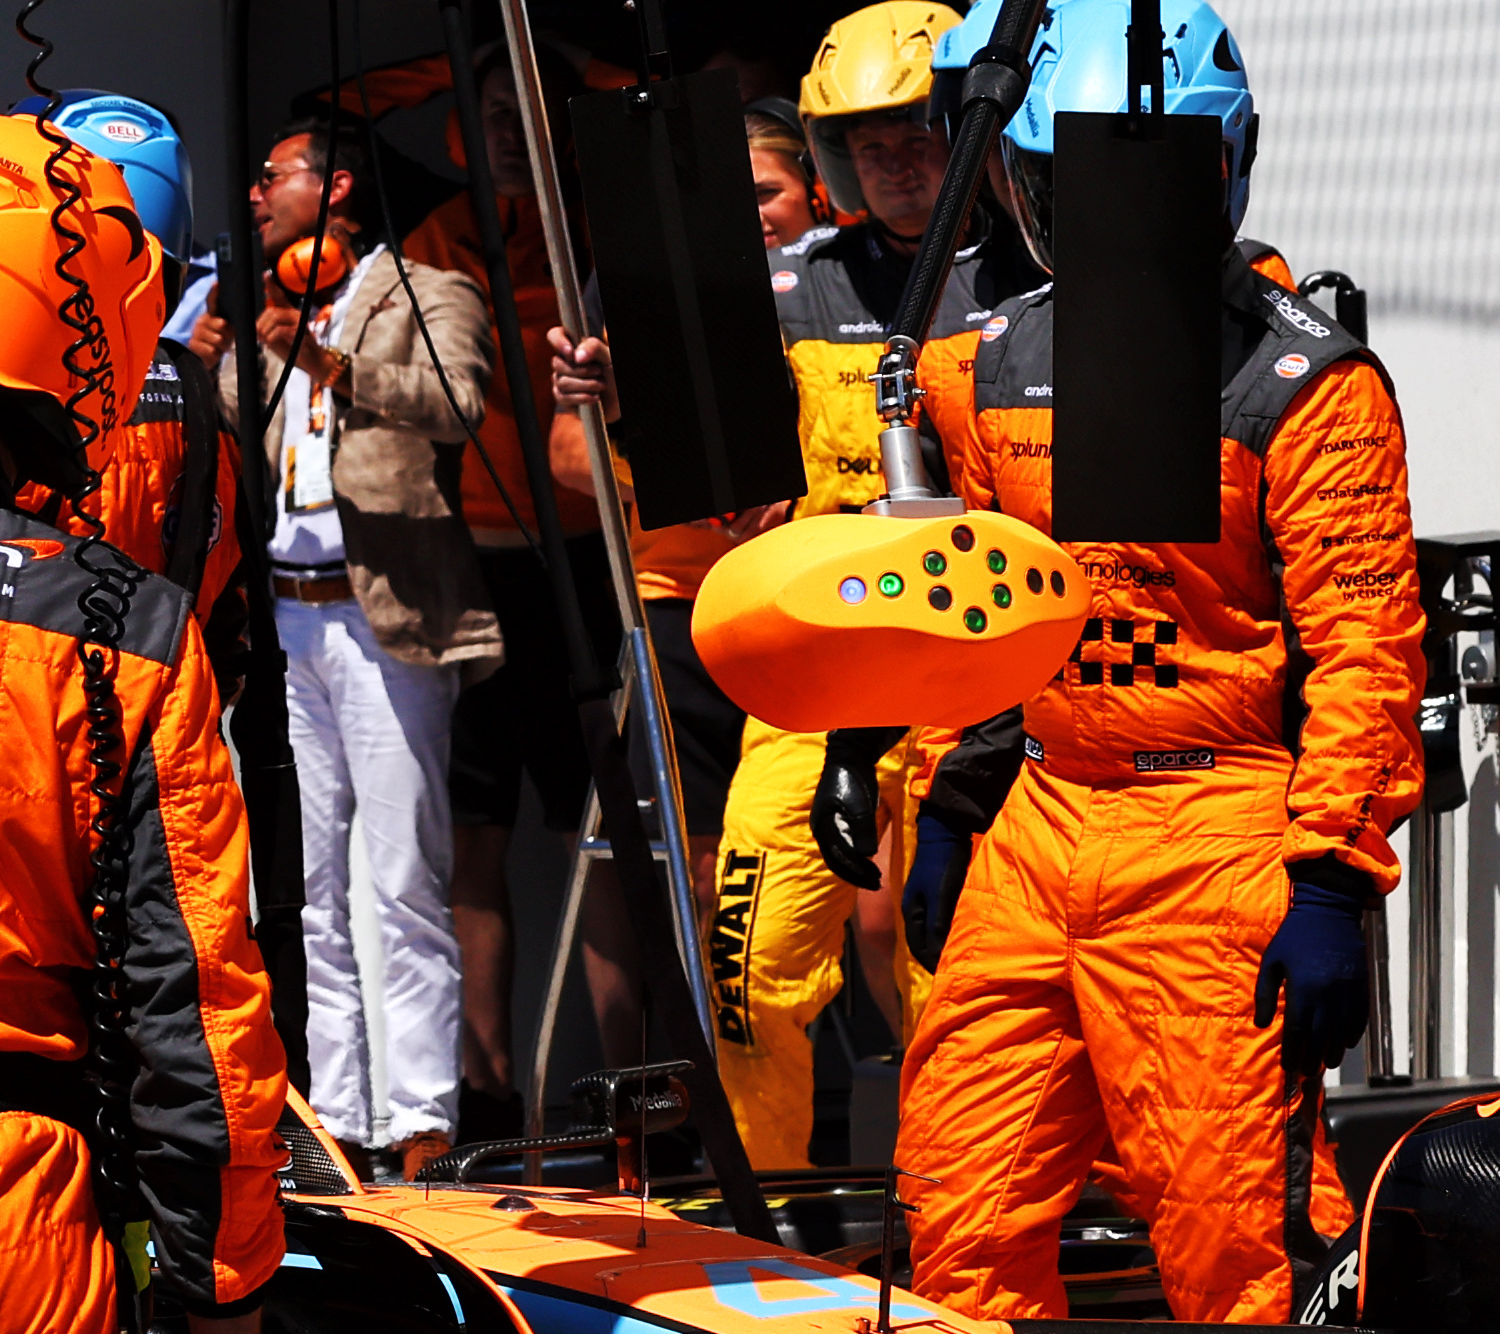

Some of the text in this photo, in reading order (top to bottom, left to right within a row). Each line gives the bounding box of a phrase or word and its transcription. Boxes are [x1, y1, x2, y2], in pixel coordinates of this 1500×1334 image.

[1025, 97, 1041, 139] Medallia
[107, 125, 140, 138] BELL
[1262, 289, 1332, 339] sparco
[1277, 360, 1307, 373] Gulf
[1323, 436, 1388, 455] DARKTRACE
[1328, 483, 1394, 501] DataRobot
[1334, 531, 1402, 545] smartsheet
[1332, 569, 1400, 590] webex
[1342, 587, 1394, 602] by cisco
[1137, 750, 1213, 770] sparco
[717, 849, 766, 1046] DEWALT
[629, 1089, 683, 1113] Medallia
